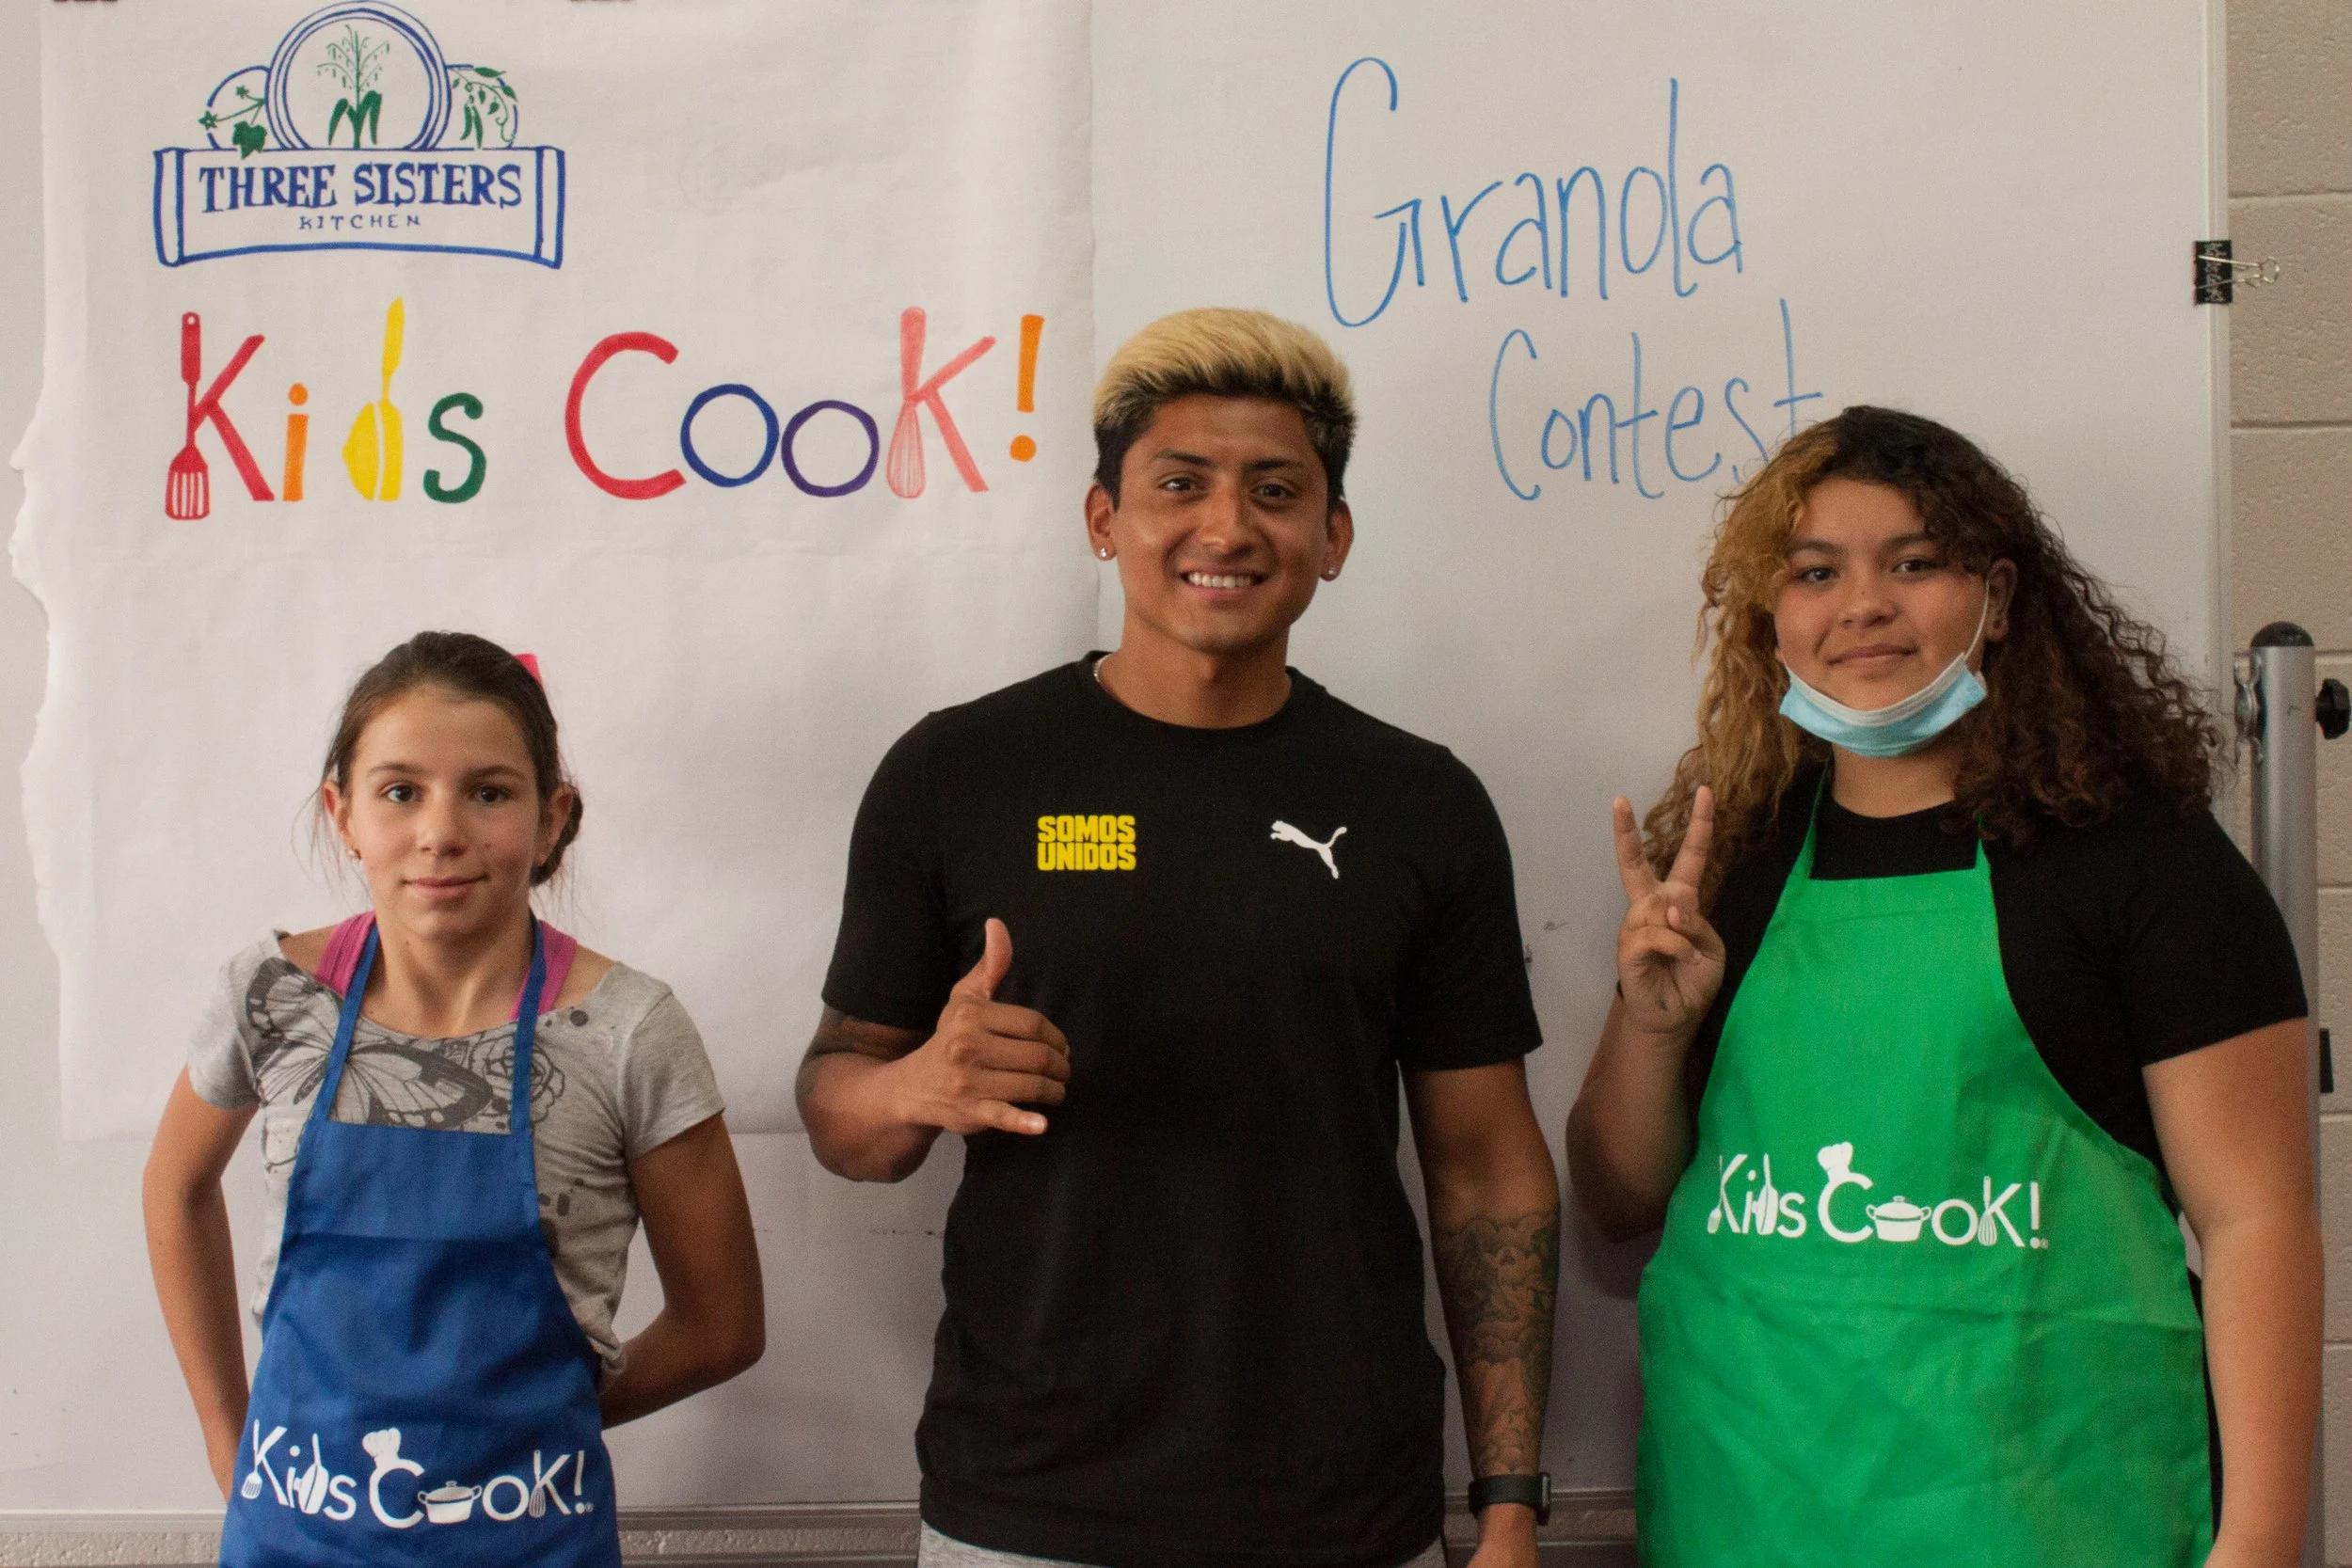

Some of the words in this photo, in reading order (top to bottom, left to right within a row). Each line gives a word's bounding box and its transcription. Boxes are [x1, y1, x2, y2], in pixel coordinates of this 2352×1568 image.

[199, 163, 338, 214] THREE
[353, 161, 523, 210] SISTERS
[298, 214, 421, 230] KITCHEN
[1326, 56, 1743, 328] Granola
[165, 296, 487, 521] Kids
[1489, 298, 1823, 501] Contest
[1037, 815, 1136, 843] SOMOS
[1037, 842, 1137, 871] UNIDOS
[1707, 1152, 1807, 1239] Kids
[240, 1418, 358, 1521] Kids
